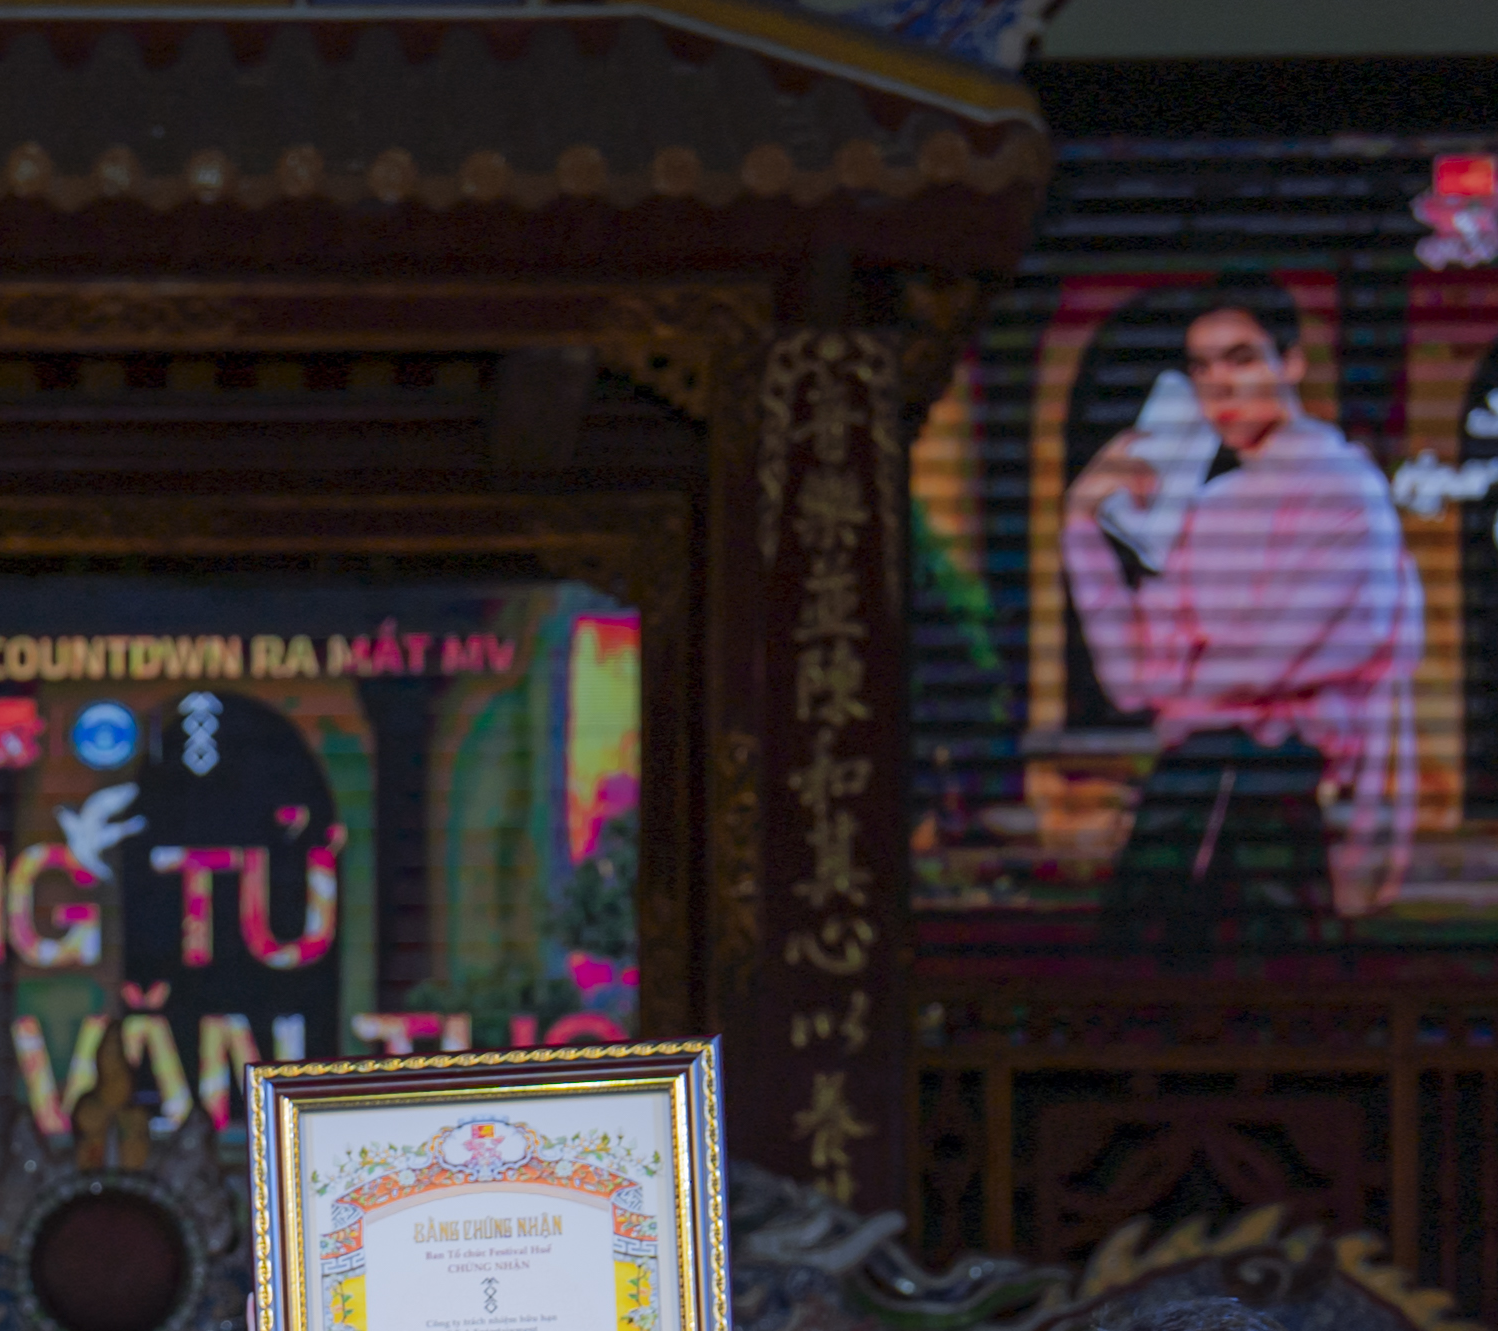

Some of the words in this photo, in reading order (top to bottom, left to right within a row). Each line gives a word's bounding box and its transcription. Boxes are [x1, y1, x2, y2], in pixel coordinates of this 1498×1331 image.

[250, 633, 321, 680] RA
[441, 632, 516, 677] MV
[151, 805, 349, 968] TỬ
[489, 1245, 527, 1257] Festival
